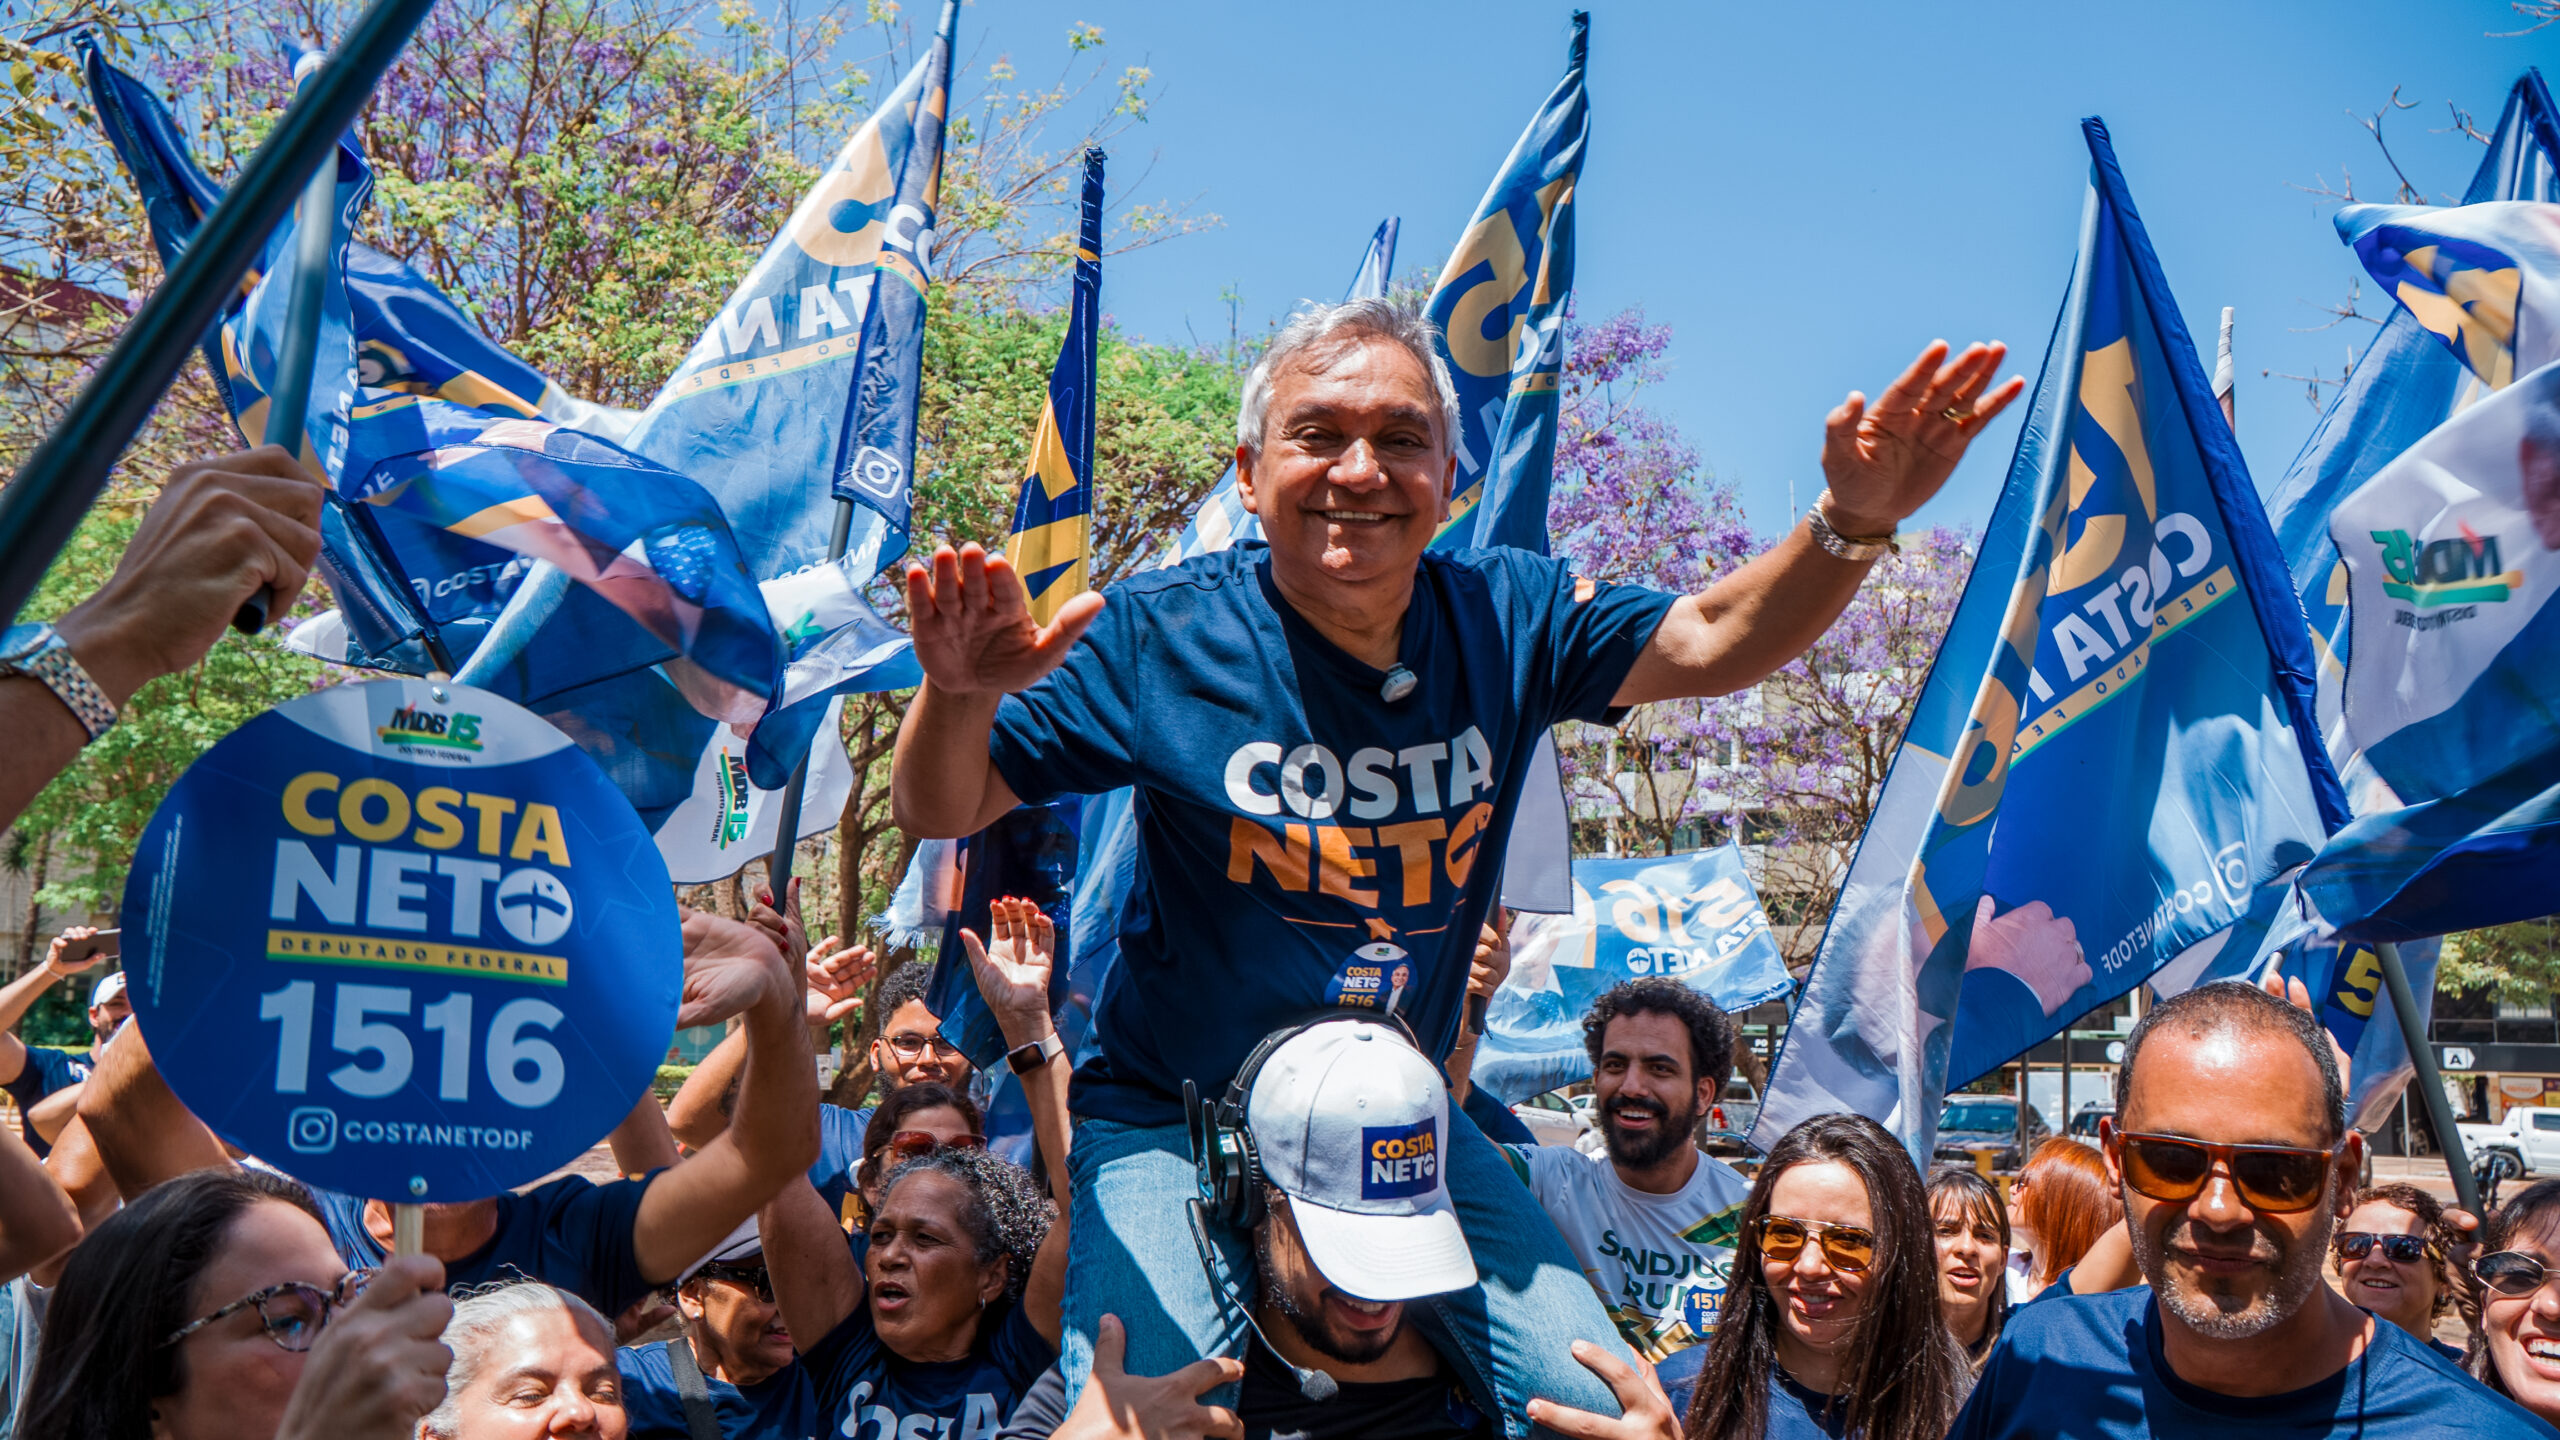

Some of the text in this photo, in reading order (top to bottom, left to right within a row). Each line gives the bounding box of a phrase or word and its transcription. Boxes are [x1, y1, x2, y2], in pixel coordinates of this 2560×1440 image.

[1223, 724, 1494, 820] COSTA
[281, 770, 572, 868] COSTA
[269, 837, 574, 946] NETO
[281, 936, 556, 977] DEPUTADO FEDERAL
[1346, 966, 1382, 977] COSTA
[1342, 976, 1381, 988] NETO
[1338, 993, 1376, 1007] 1516
[258, 979, 566, 1108] 1516
[2449, 1054, 2463, 1066] A
[342, 1120, 534, 1151] COSTANETODF
[1371, 1132, 1435, 1160] COSTA
[1371, 1152, 1436, 1184] NETO
